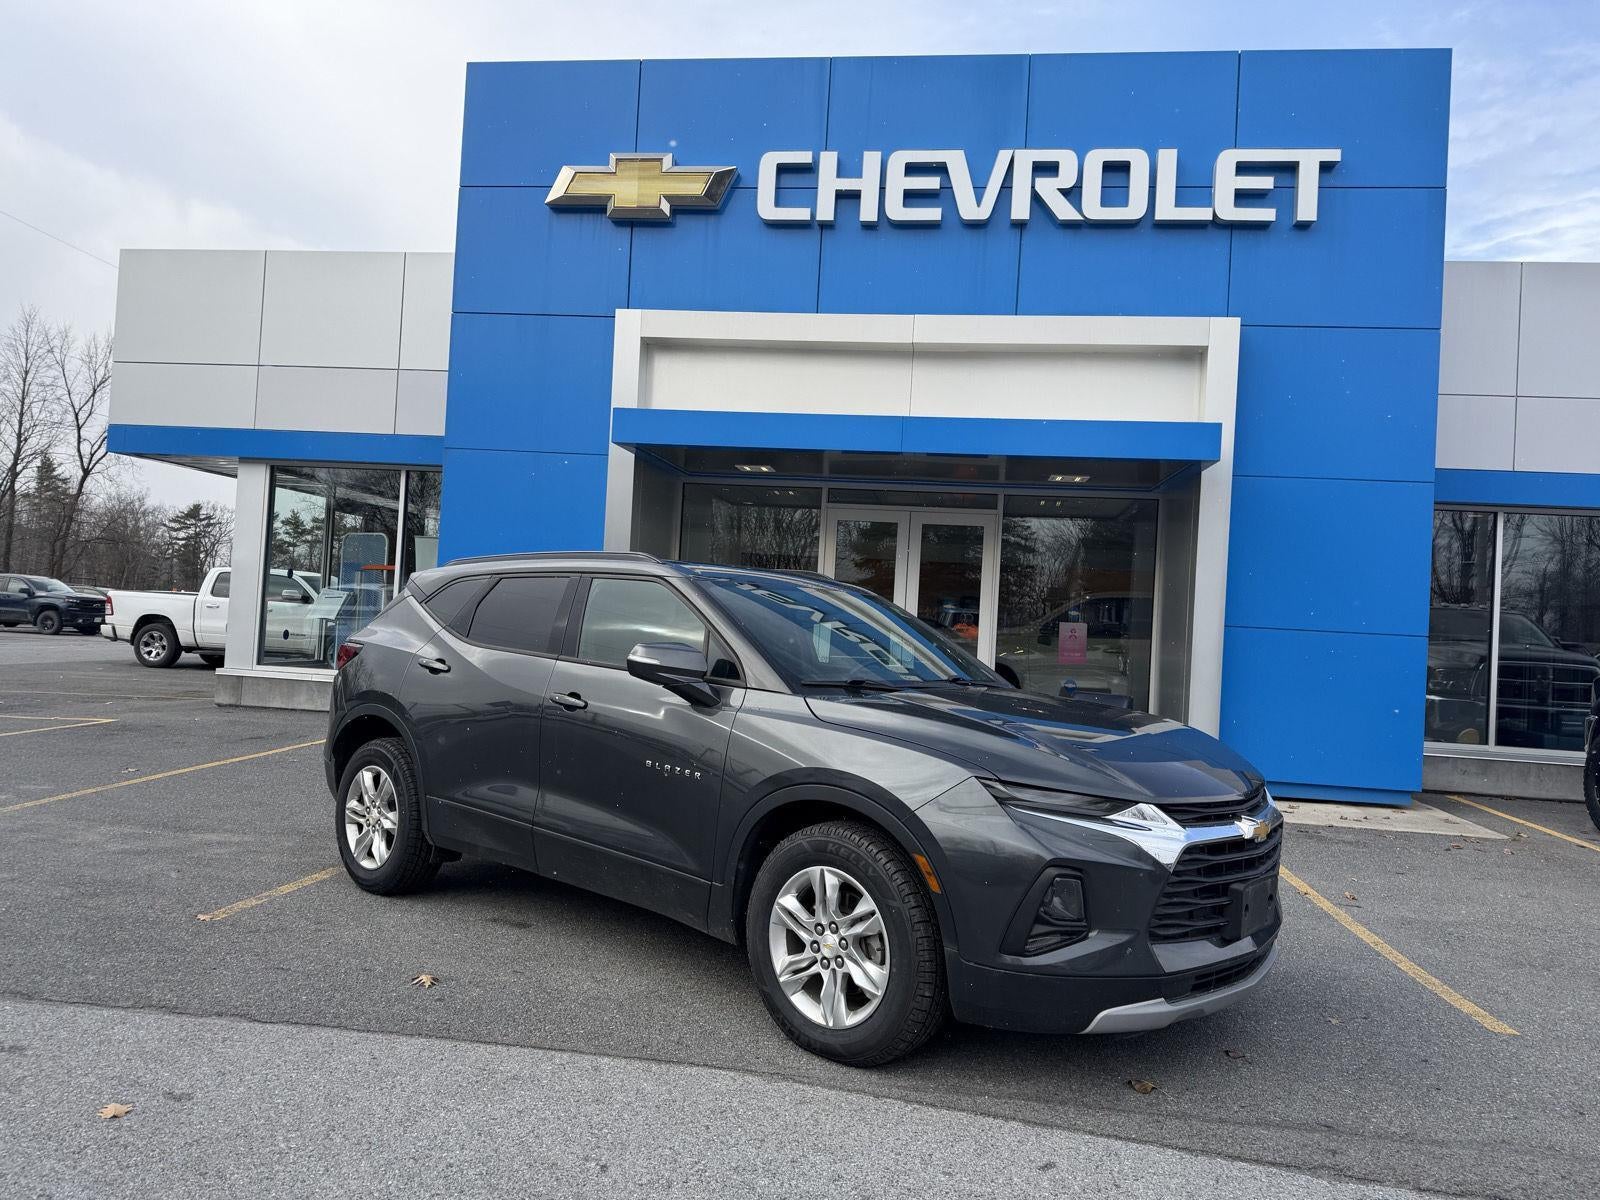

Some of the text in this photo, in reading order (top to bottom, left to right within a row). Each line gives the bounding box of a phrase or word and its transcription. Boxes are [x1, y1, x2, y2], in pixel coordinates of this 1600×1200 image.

[756, 148, 1342, 225] CHEVROLET
[645, 759, 702, 780] BLAZER
[826, 841, 880, 877] KELLY
